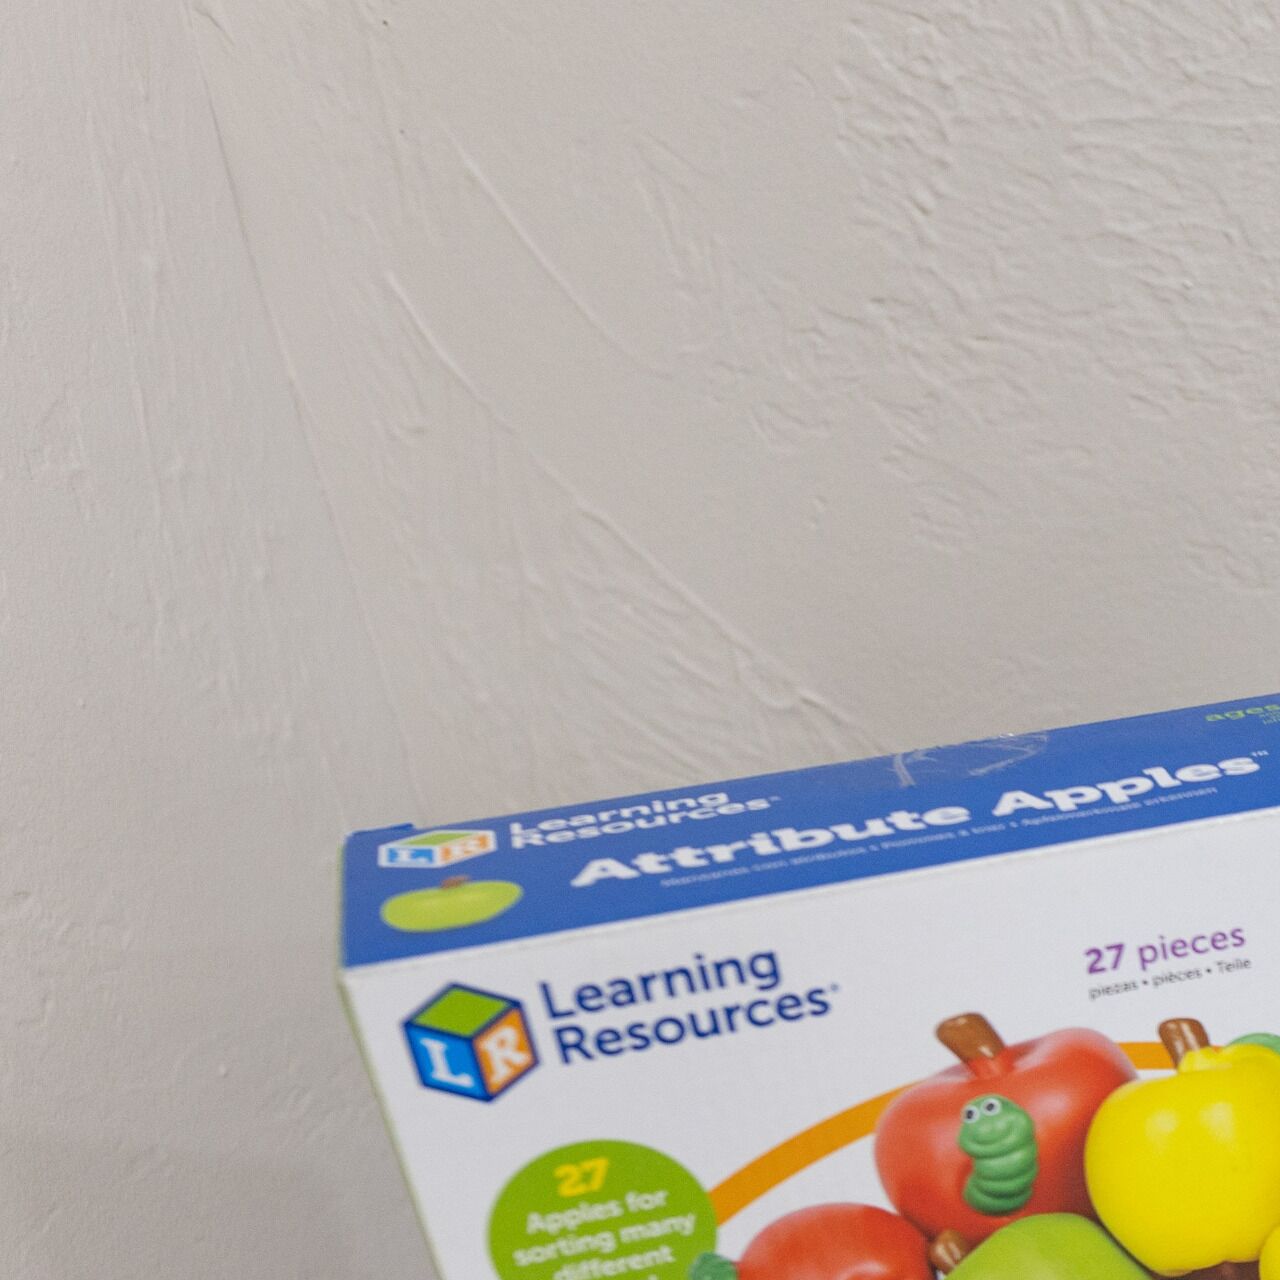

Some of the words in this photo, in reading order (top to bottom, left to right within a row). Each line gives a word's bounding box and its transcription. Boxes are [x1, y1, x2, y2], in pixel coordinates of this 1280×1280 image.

[1205, 704, 1280, 722] ages
[510, 793, 729, 837] Learning
[511, 797, 771, 851] Resources
[570, 806, 971, 887] Attribute
[1085, 943, 1125, 974] 27
[1138, 928, 1246, 971] pieces
[540, 952, 780, 1018] Learning
[554, 991, 832, 1064] Resources
[553, 1156, 609, 1198] 27
[526, 1200, 625, 1235] Apples
[625, 1190, 668, 1212] for
[512, 1230, 616, 1267] sorting
